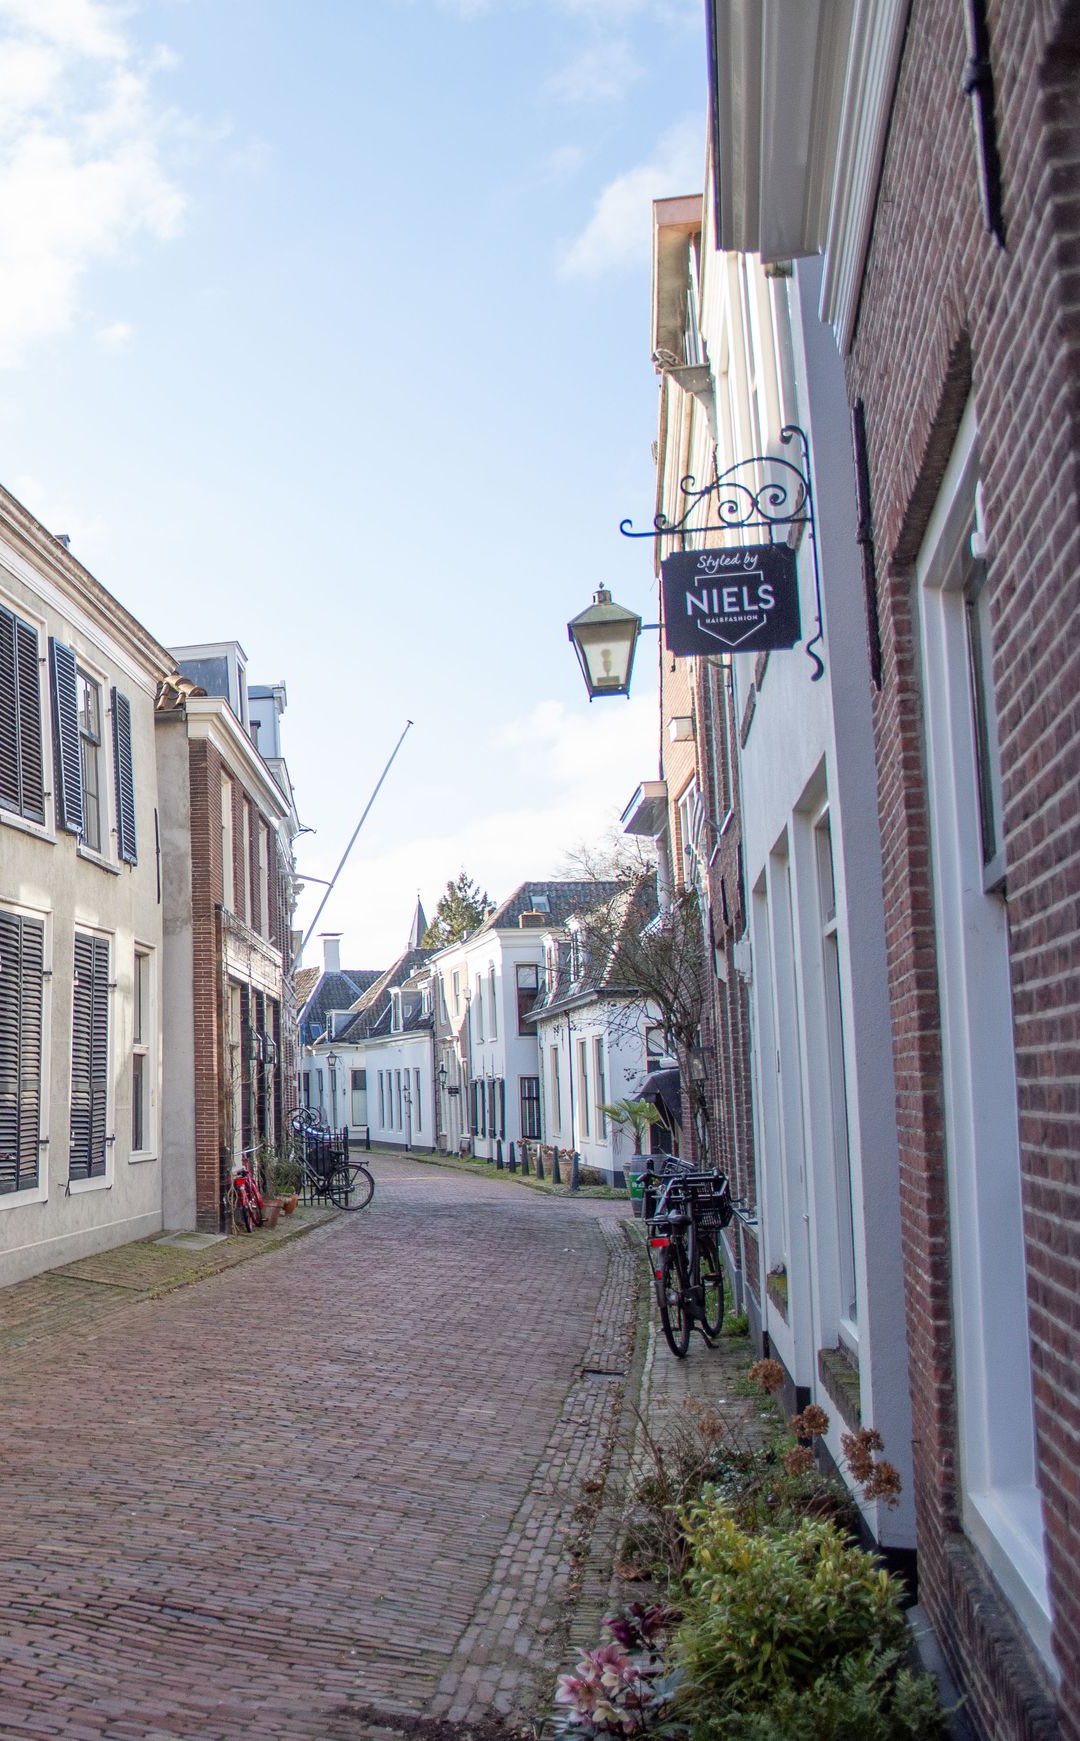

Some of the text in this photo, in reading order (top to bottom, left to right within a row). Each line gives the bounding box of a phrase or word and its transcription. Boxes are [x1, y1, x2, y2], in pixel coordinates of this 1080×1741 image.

[697, 551, 759, 574] Styled by
[685, 584, 775, 616] NIELS
[705, 614, 758, 624] HAIRFASHION
